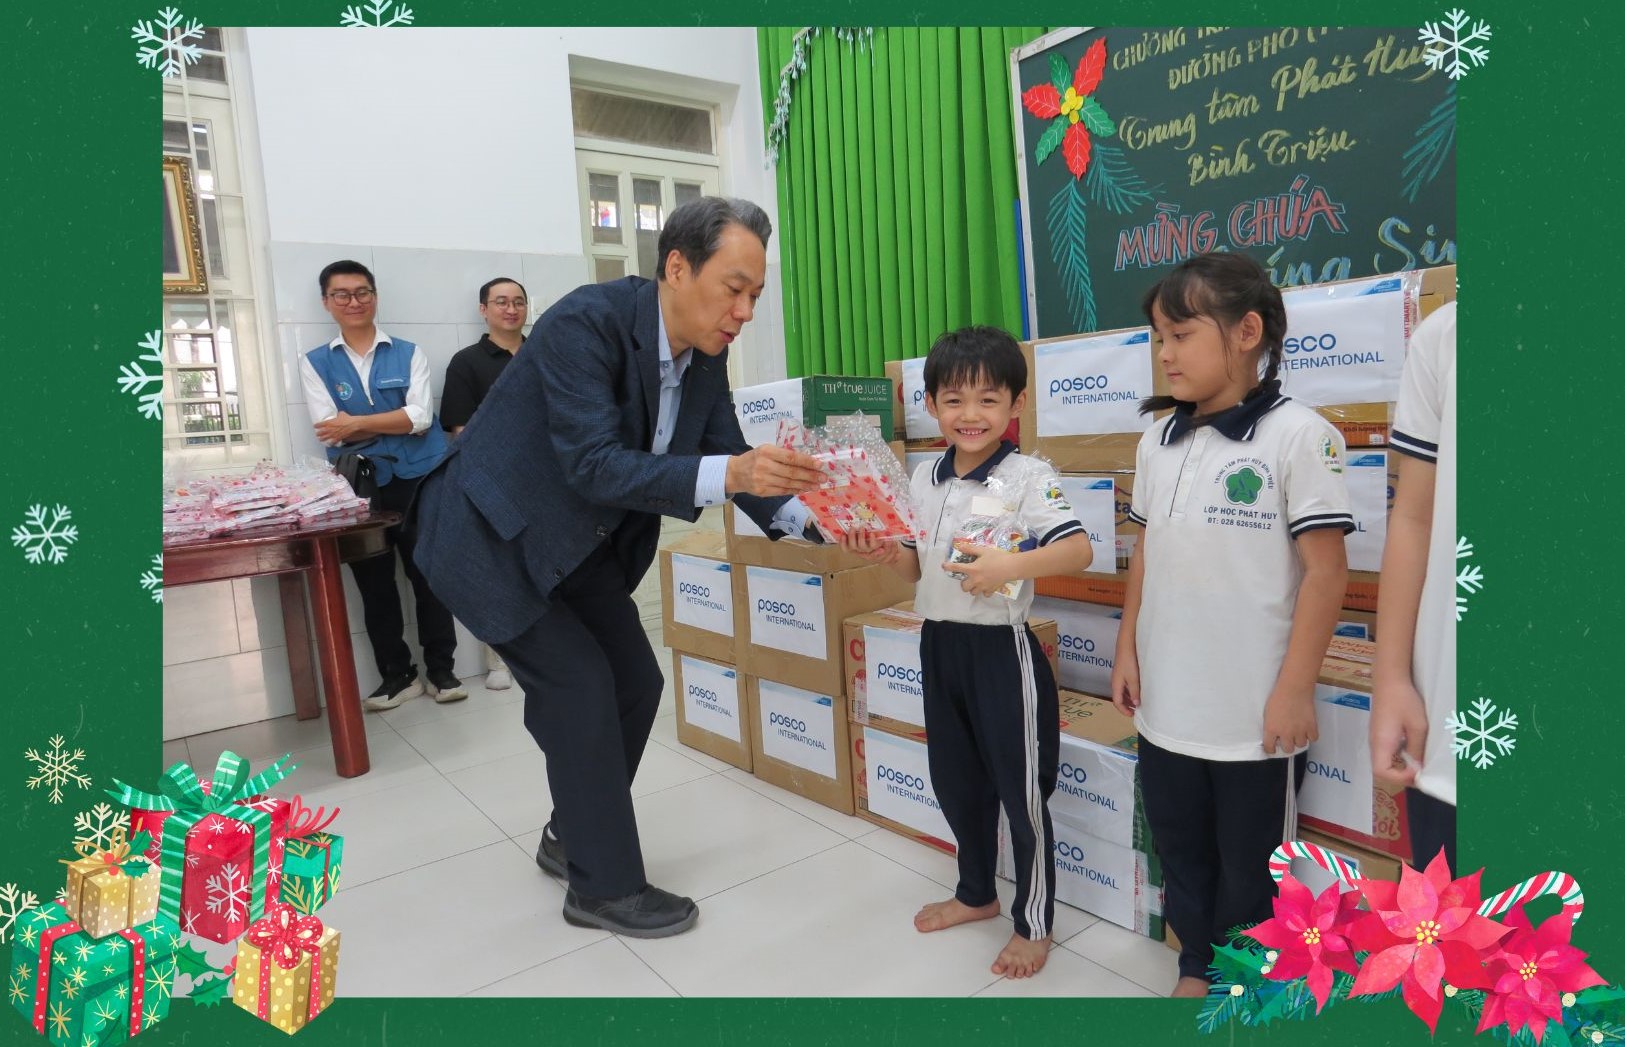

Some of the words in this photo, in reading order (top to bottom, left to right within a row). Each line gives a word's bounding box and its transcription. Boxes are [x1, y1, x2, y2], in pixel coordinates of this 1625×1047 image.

[1118, 111, 1197, 151] Trung
[1271, 53, 1358, 112] Phát
[1187, 137, 1257, 187] Bình
[1114, 202, 1219, 270] MỪNG
[1227, 173, 1349, 248] CHÚA
[1062, 390, 1139, 406] INTERNATIONAL
[750, 409, 795, 425] INTERNATIONAL
[1260, 511, 1278, 521] HUY
[686, 596, 727, 613] INTERNATIONAL
[765, 613, 817, 632] INTERNATIONAL
[695, 697, 733, 718] INTERNATIONAL
[777, 728, 827, 751] INTERNATIONAL
[887, 783, 941, 811] INTERNATION
